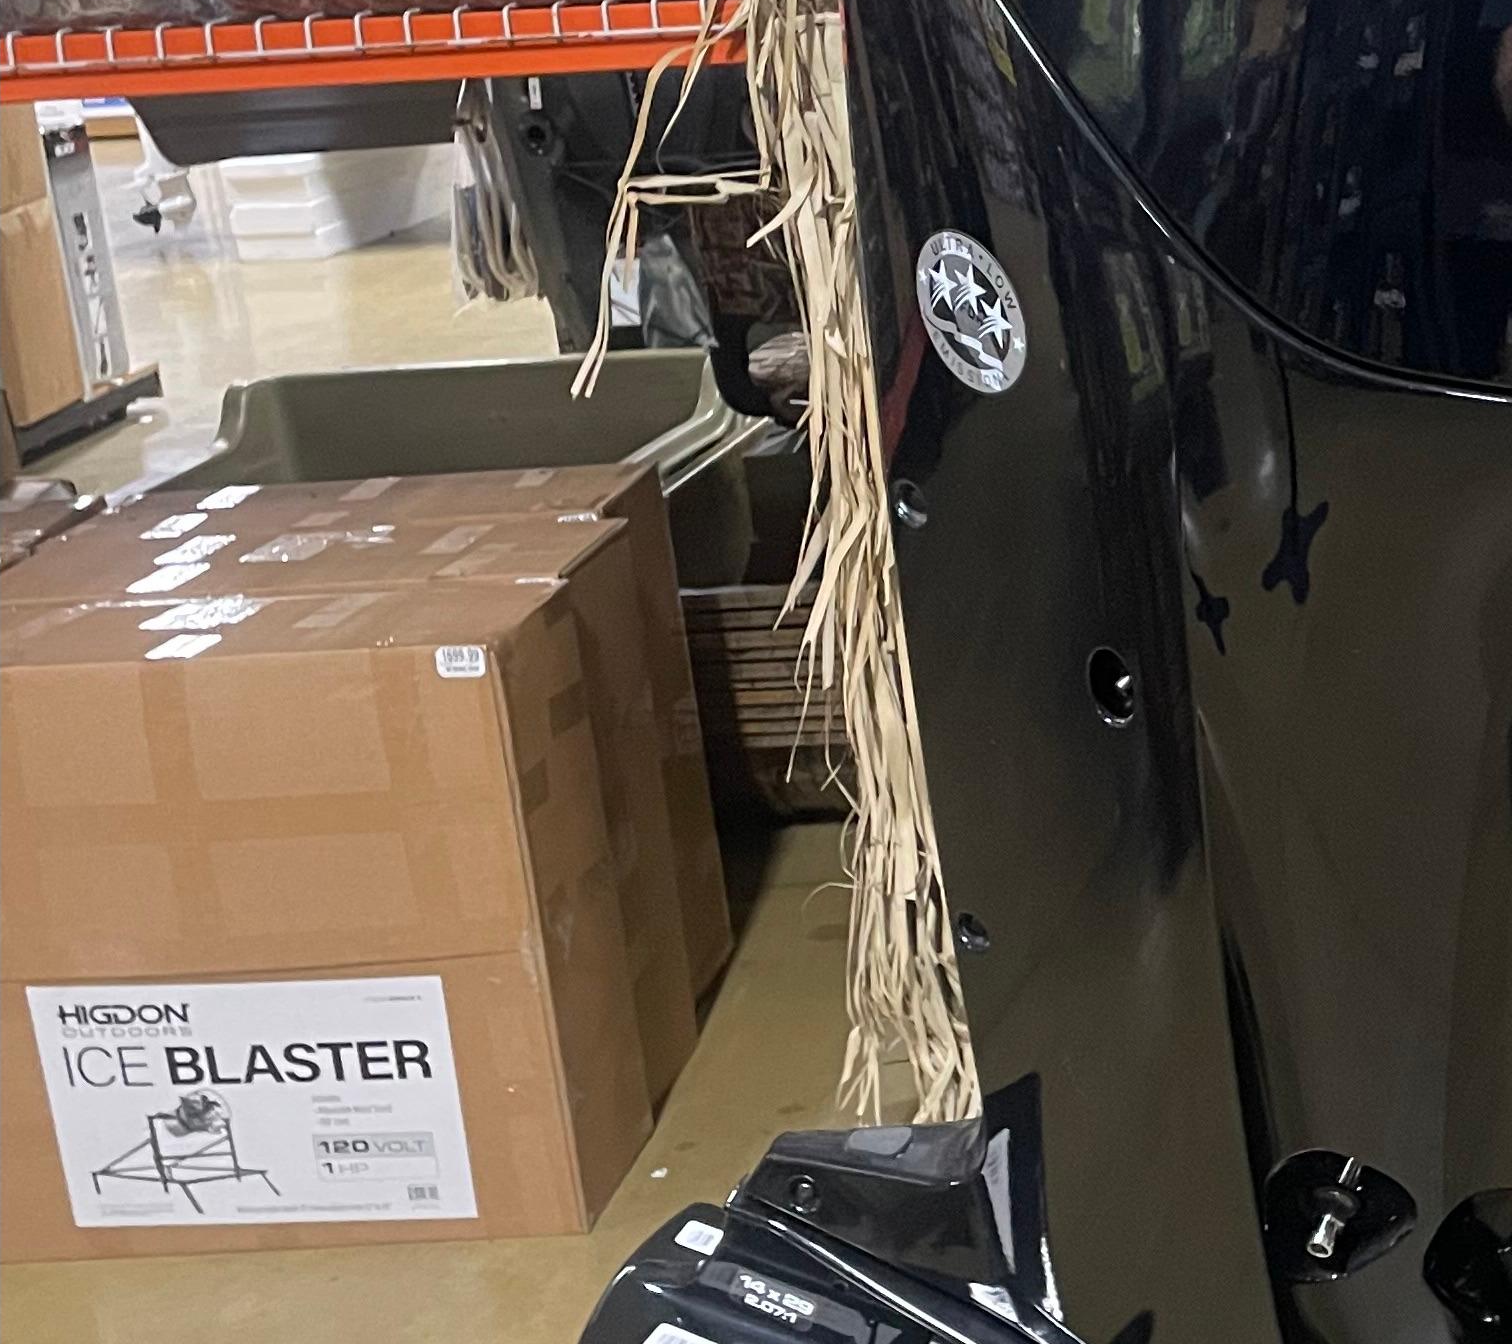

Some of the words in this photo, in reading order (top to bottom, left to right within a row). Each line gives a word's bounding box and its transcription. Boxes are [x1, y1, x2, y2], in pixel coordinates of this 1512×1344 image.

[929, 236, 975, 258] ULTRA
[986, 262, 1018, 309] LOW
[58, 1003, 191, 1026] HIGDON
[62, 1026, 193, 1039] OUTDOORS
[62, 1045, 154, 1088] ICE
[164, 1039, 433, 1086] BLASTER
[319, 1139, 370, 1154] 120
[373, 1139, 426, 1154] VOLT
[321, 1162, 334, 1174] 1
[338, 1162, 370, 1174] HP
[739, 1274, 766, 1295] 14
[782, 1293, 815, 1316] 29
